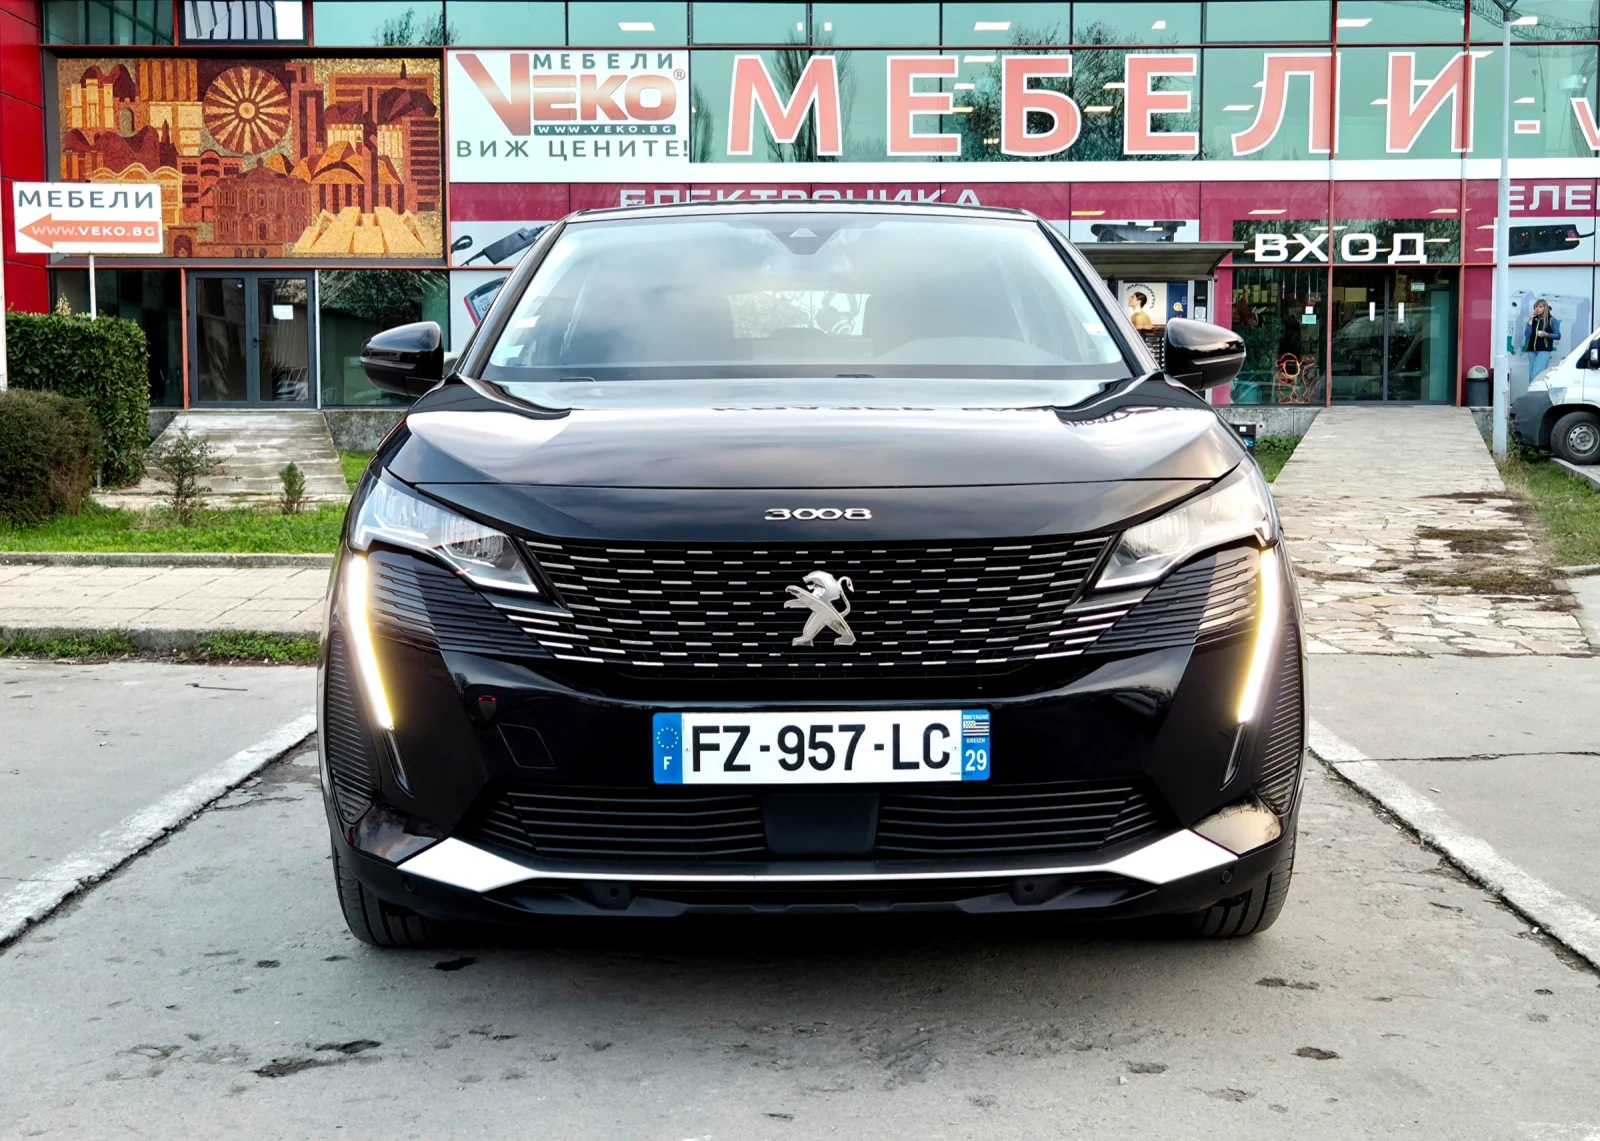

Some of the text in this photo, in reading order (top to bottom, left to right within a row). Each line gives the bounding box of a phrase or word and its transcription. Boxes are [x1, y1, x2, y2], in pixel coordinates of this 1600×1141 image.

[533, 53, 673, 70] МЕБЕЛИ
[726, 51, 1475, 156] МЕБЕЛИ
[537, 125, 672, 134] WWW.VEKO.BG
[456, 140, 689, 161] ВИЖ ЦЕНИТЕ!
[18, 190, 153, 209] МЕБЕЛИ
[1509, 185, 1600, 211] ЕЛЕ
[1254, 233, 1428, 265] ВХОД
[764, 508, 873, 520] 3008
[692, 722, 951, 772] FZ-957-LC
[663, 756, 673, 770] F
[965, 749, 988, 771] 29
